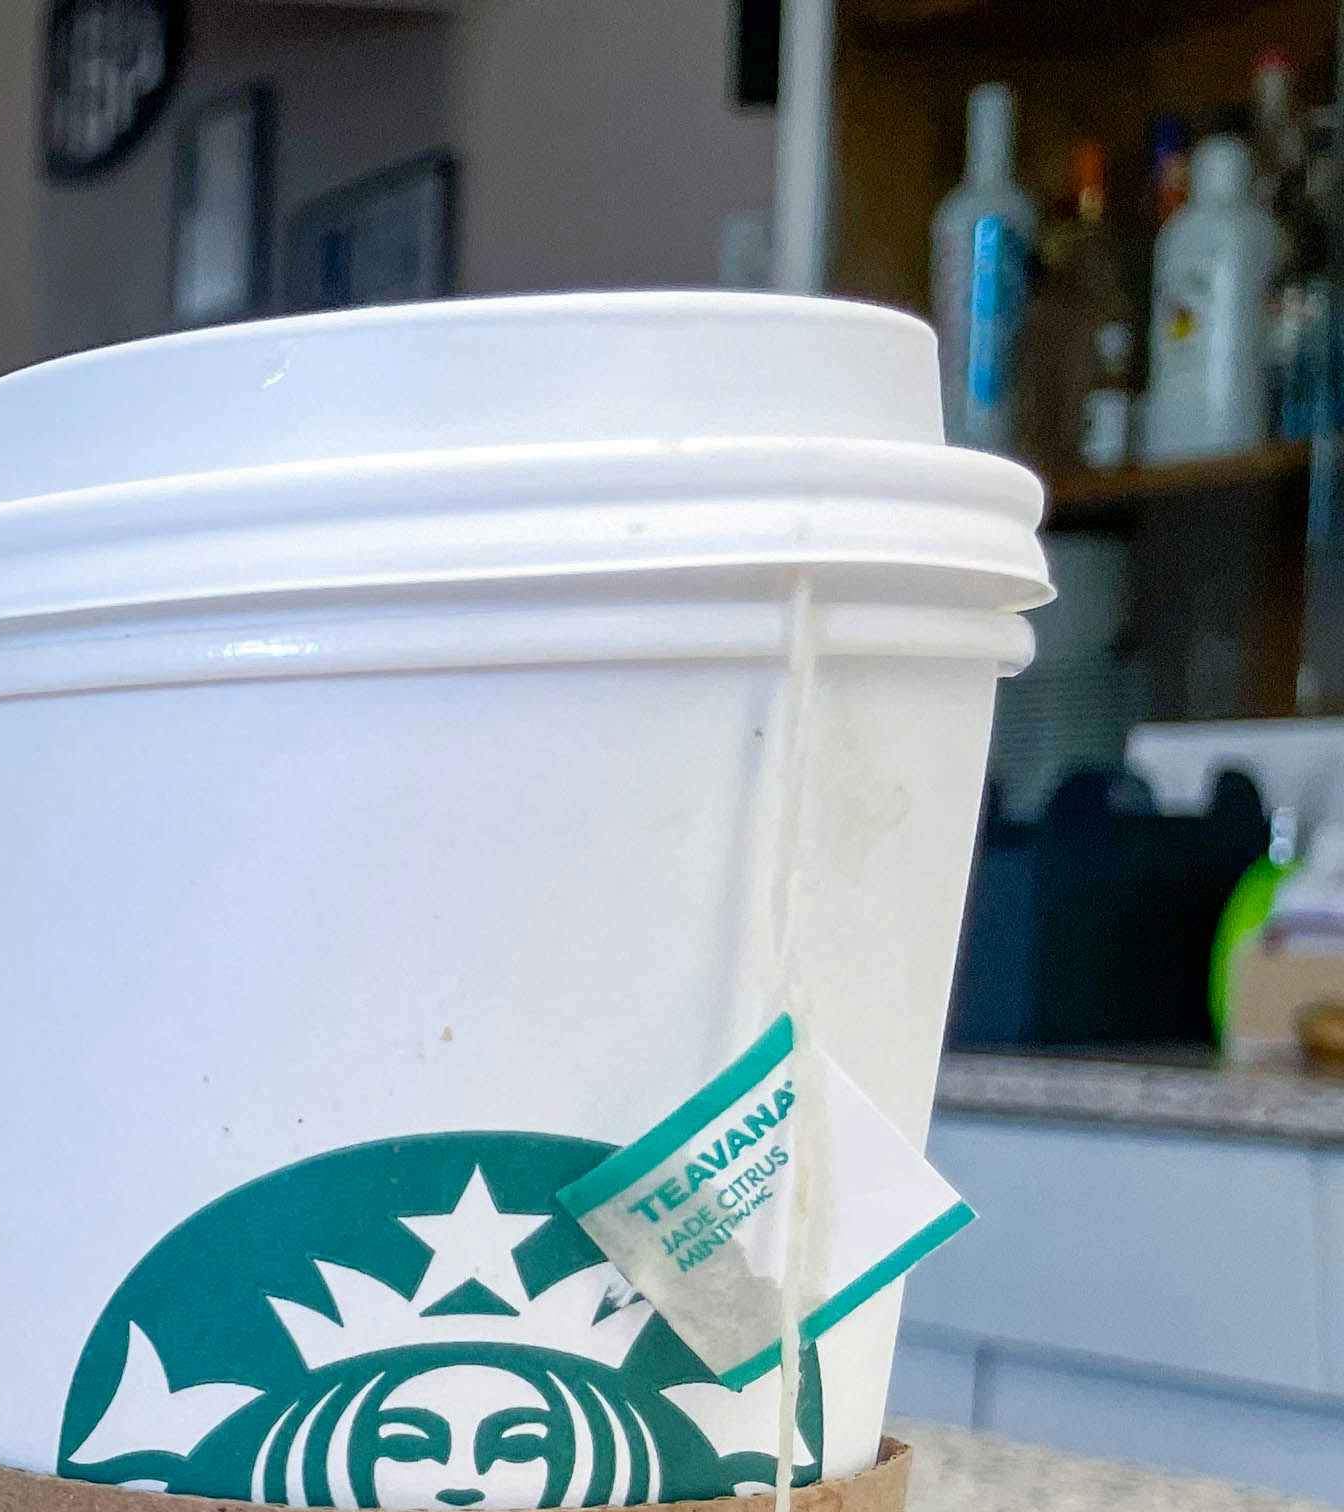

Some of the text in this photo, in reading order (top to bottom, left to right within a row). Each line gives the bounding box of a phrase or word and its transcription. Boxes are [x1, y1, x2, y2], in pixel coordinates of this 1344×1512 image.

[628, 1086, 796, 1225] TEAVANA
[662, 1145, 790, 1256] JADE CITRUS
